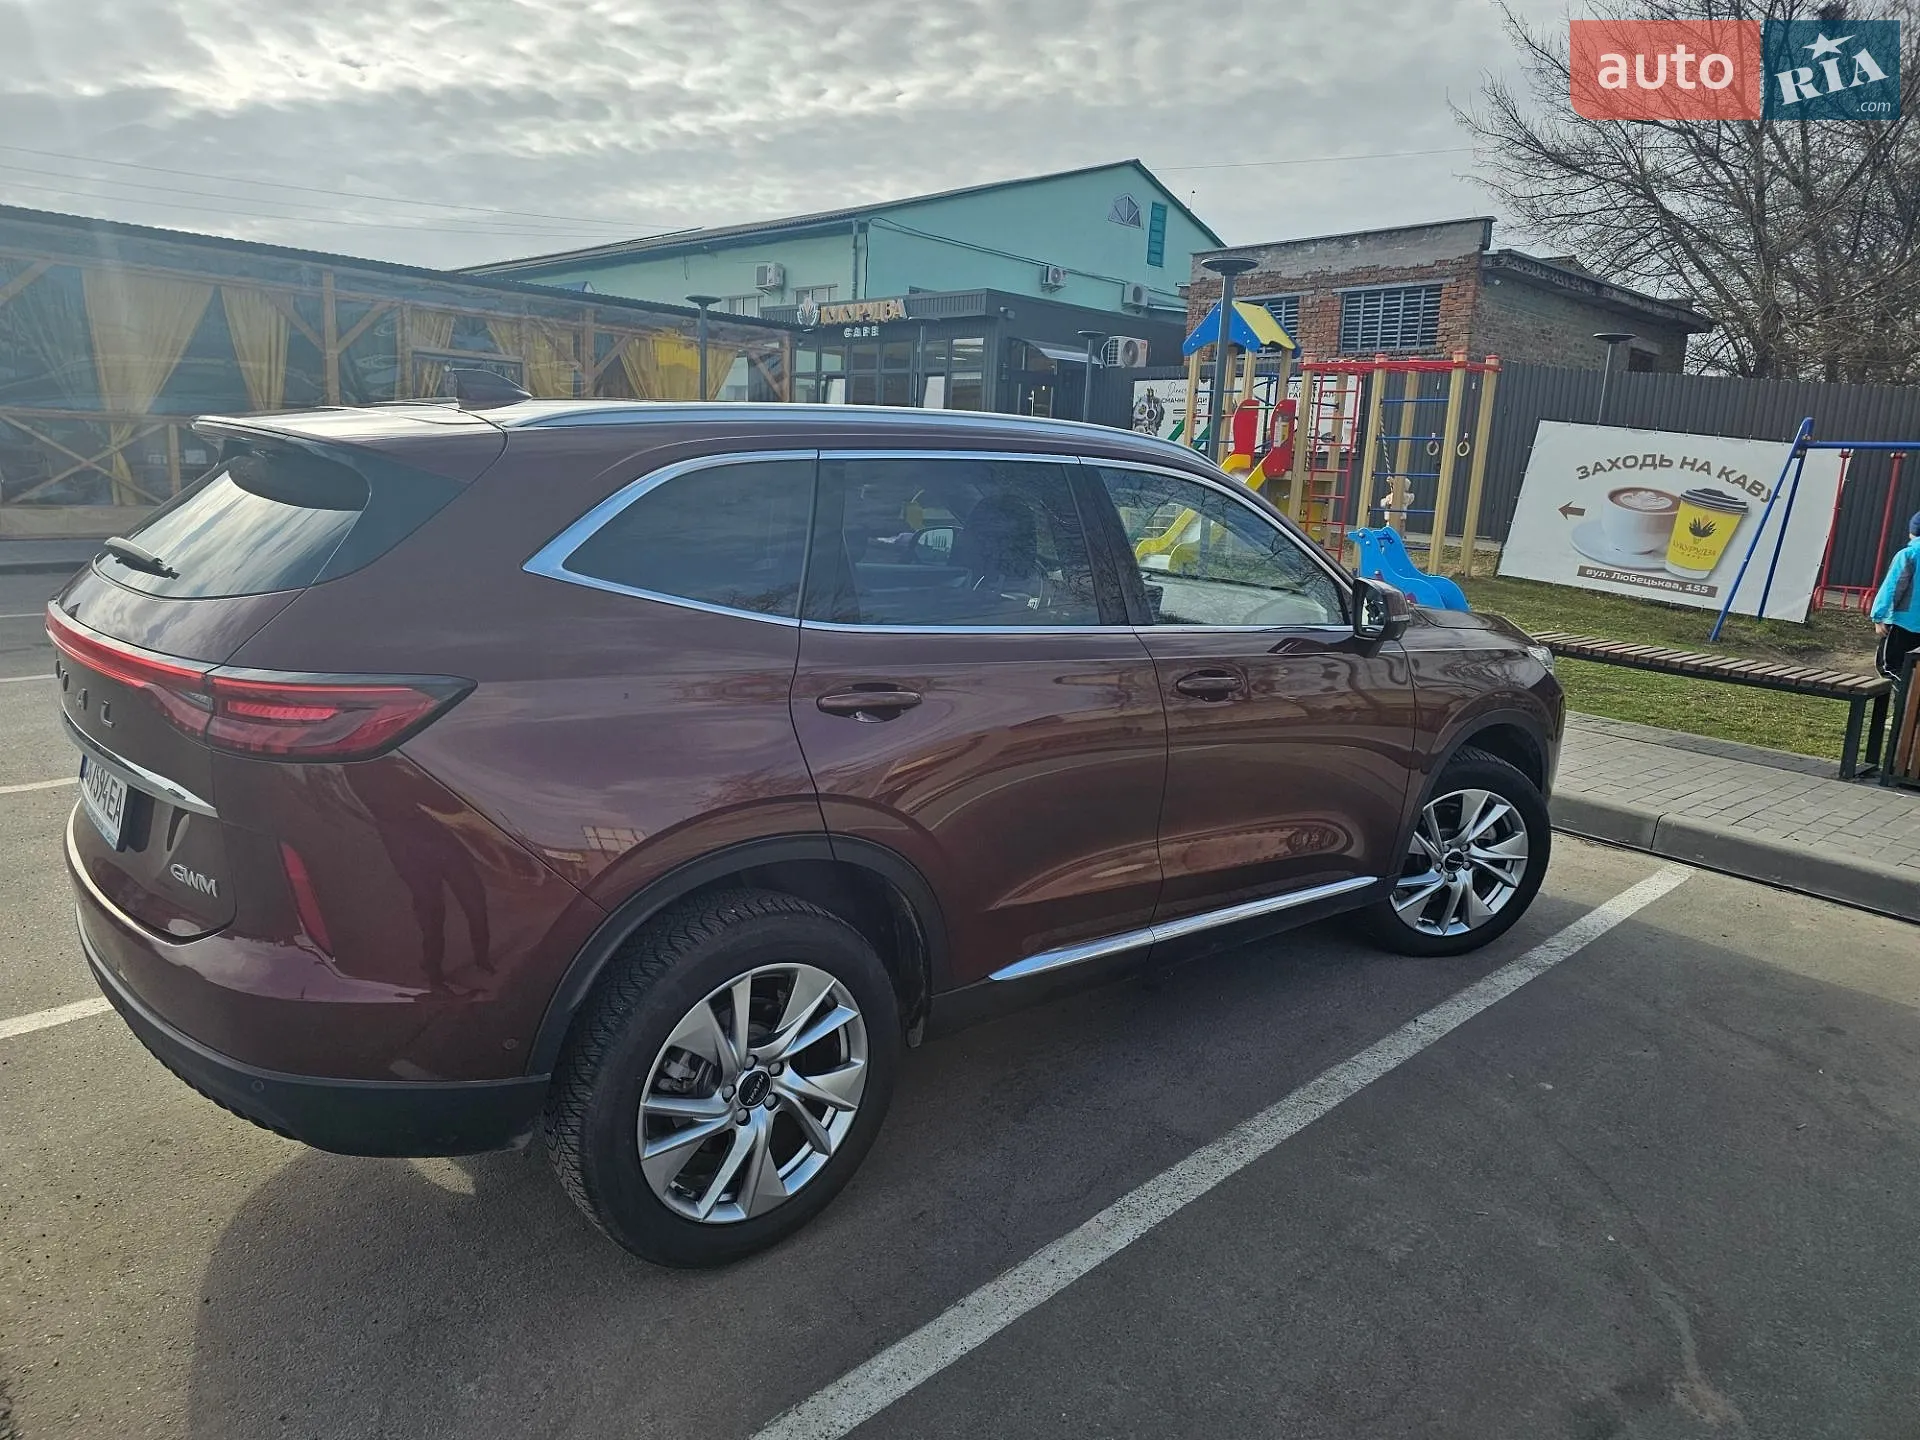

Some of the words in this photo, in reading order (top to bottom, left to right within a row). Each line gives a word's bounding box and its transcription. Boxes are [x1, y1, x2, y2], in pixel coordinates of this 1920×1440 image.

[1576, 453, 1674, 480] ЗАХОДЬ
[1679, 456, 1713, 476] НА
[1586, 568, 1609, 579] вул.
[1685, 583, 1709, 594] 155
[170, 863, 218, 899] GWM
